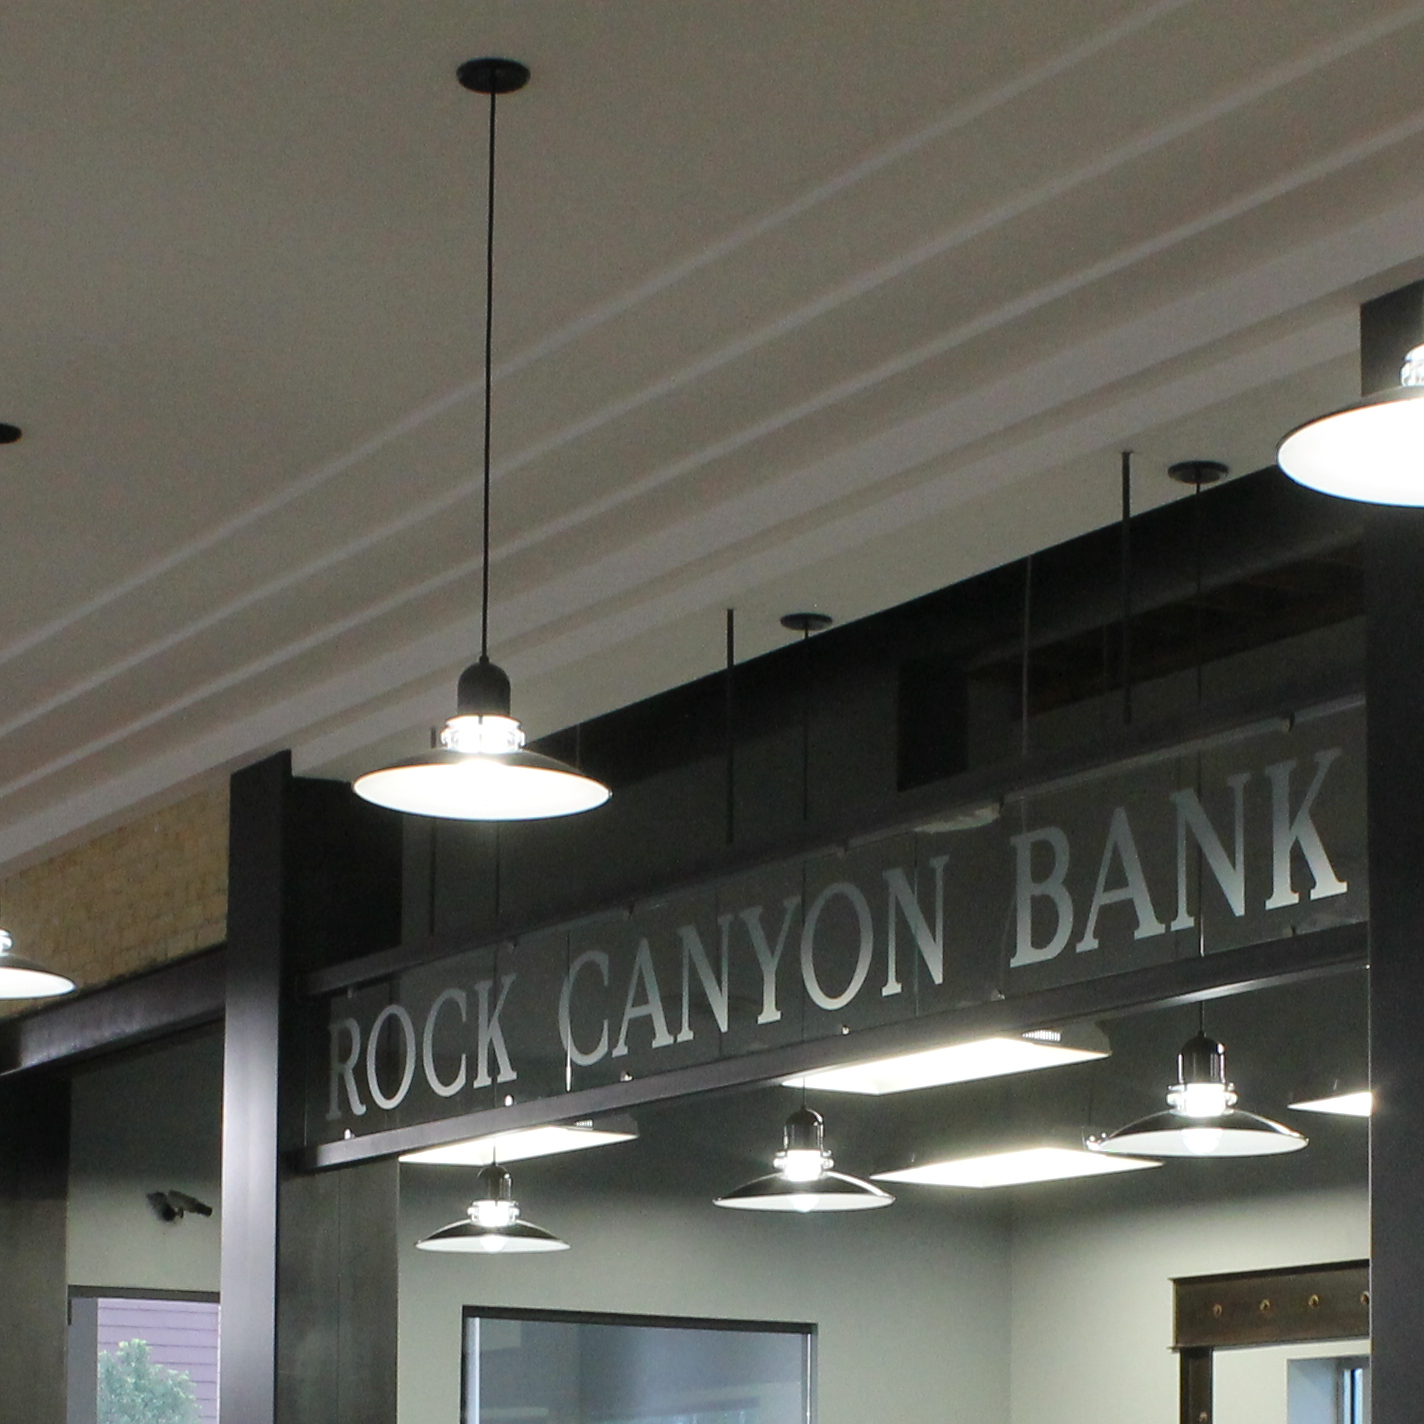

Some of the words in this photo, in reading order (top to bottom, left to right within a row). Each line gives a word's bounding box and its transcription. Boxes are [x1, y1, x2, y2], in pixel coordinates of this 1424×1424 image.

[326, 973, 518, 1121] ROCK
[558, 854, 949, 1067] CANYON
[1010, 747, 1348, 968] BANK
